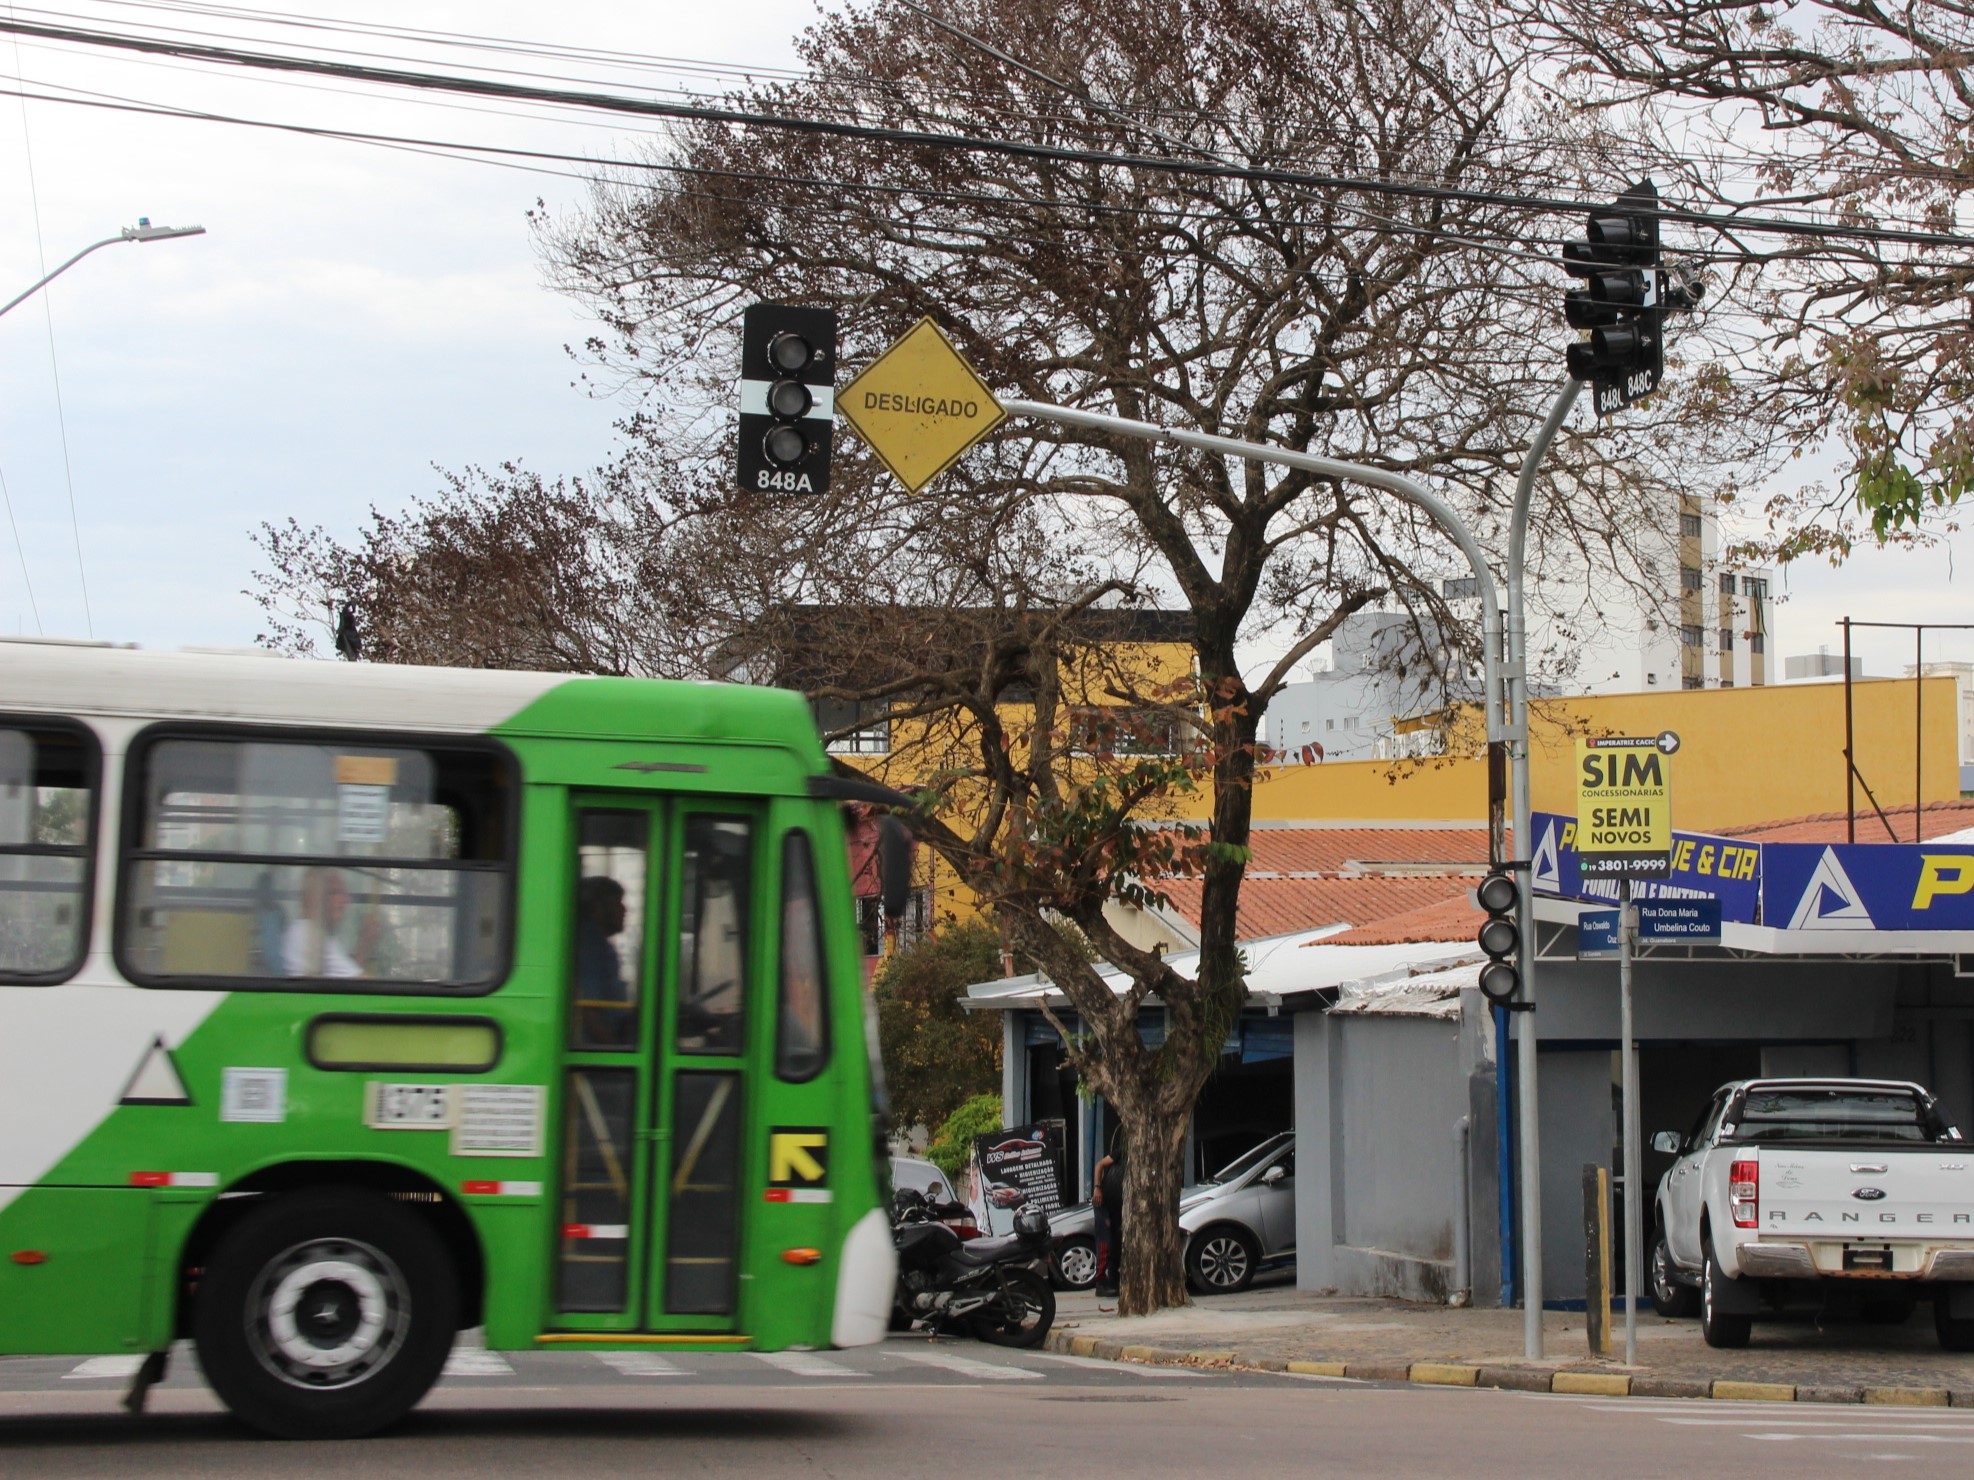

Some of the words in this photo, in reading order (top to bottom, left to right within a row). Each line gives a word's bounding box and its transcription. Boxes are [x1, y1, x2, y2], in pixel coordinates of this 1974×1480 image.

[1627, 369, 1652, 397] 848C
[864, 392, 978, 418] DESLIGADO
[757, 470, 813, 493] 848A
[1582, 753, 1663, 788] SIM
[1582, 788, 1664, 798] CONCESSIONÁRIAS
[1592, 807, 1650, 828] SEMI
[1591, 830, 1651, 844] NOVOS
[1598, 859, 1666, 871] 3801-9999
[1717, 845, 1759, 881] CIA
[1642, 908, 1656, 917] Rua
[1658, 908, 1677, 917] Dona
[1678, 908, 1698, 917] Maria
[1583, 921, 1592, 930] Rua
[1654, 923, 1687, 932] Umbelina
[1688, 923, 1710, 932] Couto
[1769, 1210, 1970, 1223] RANGER
